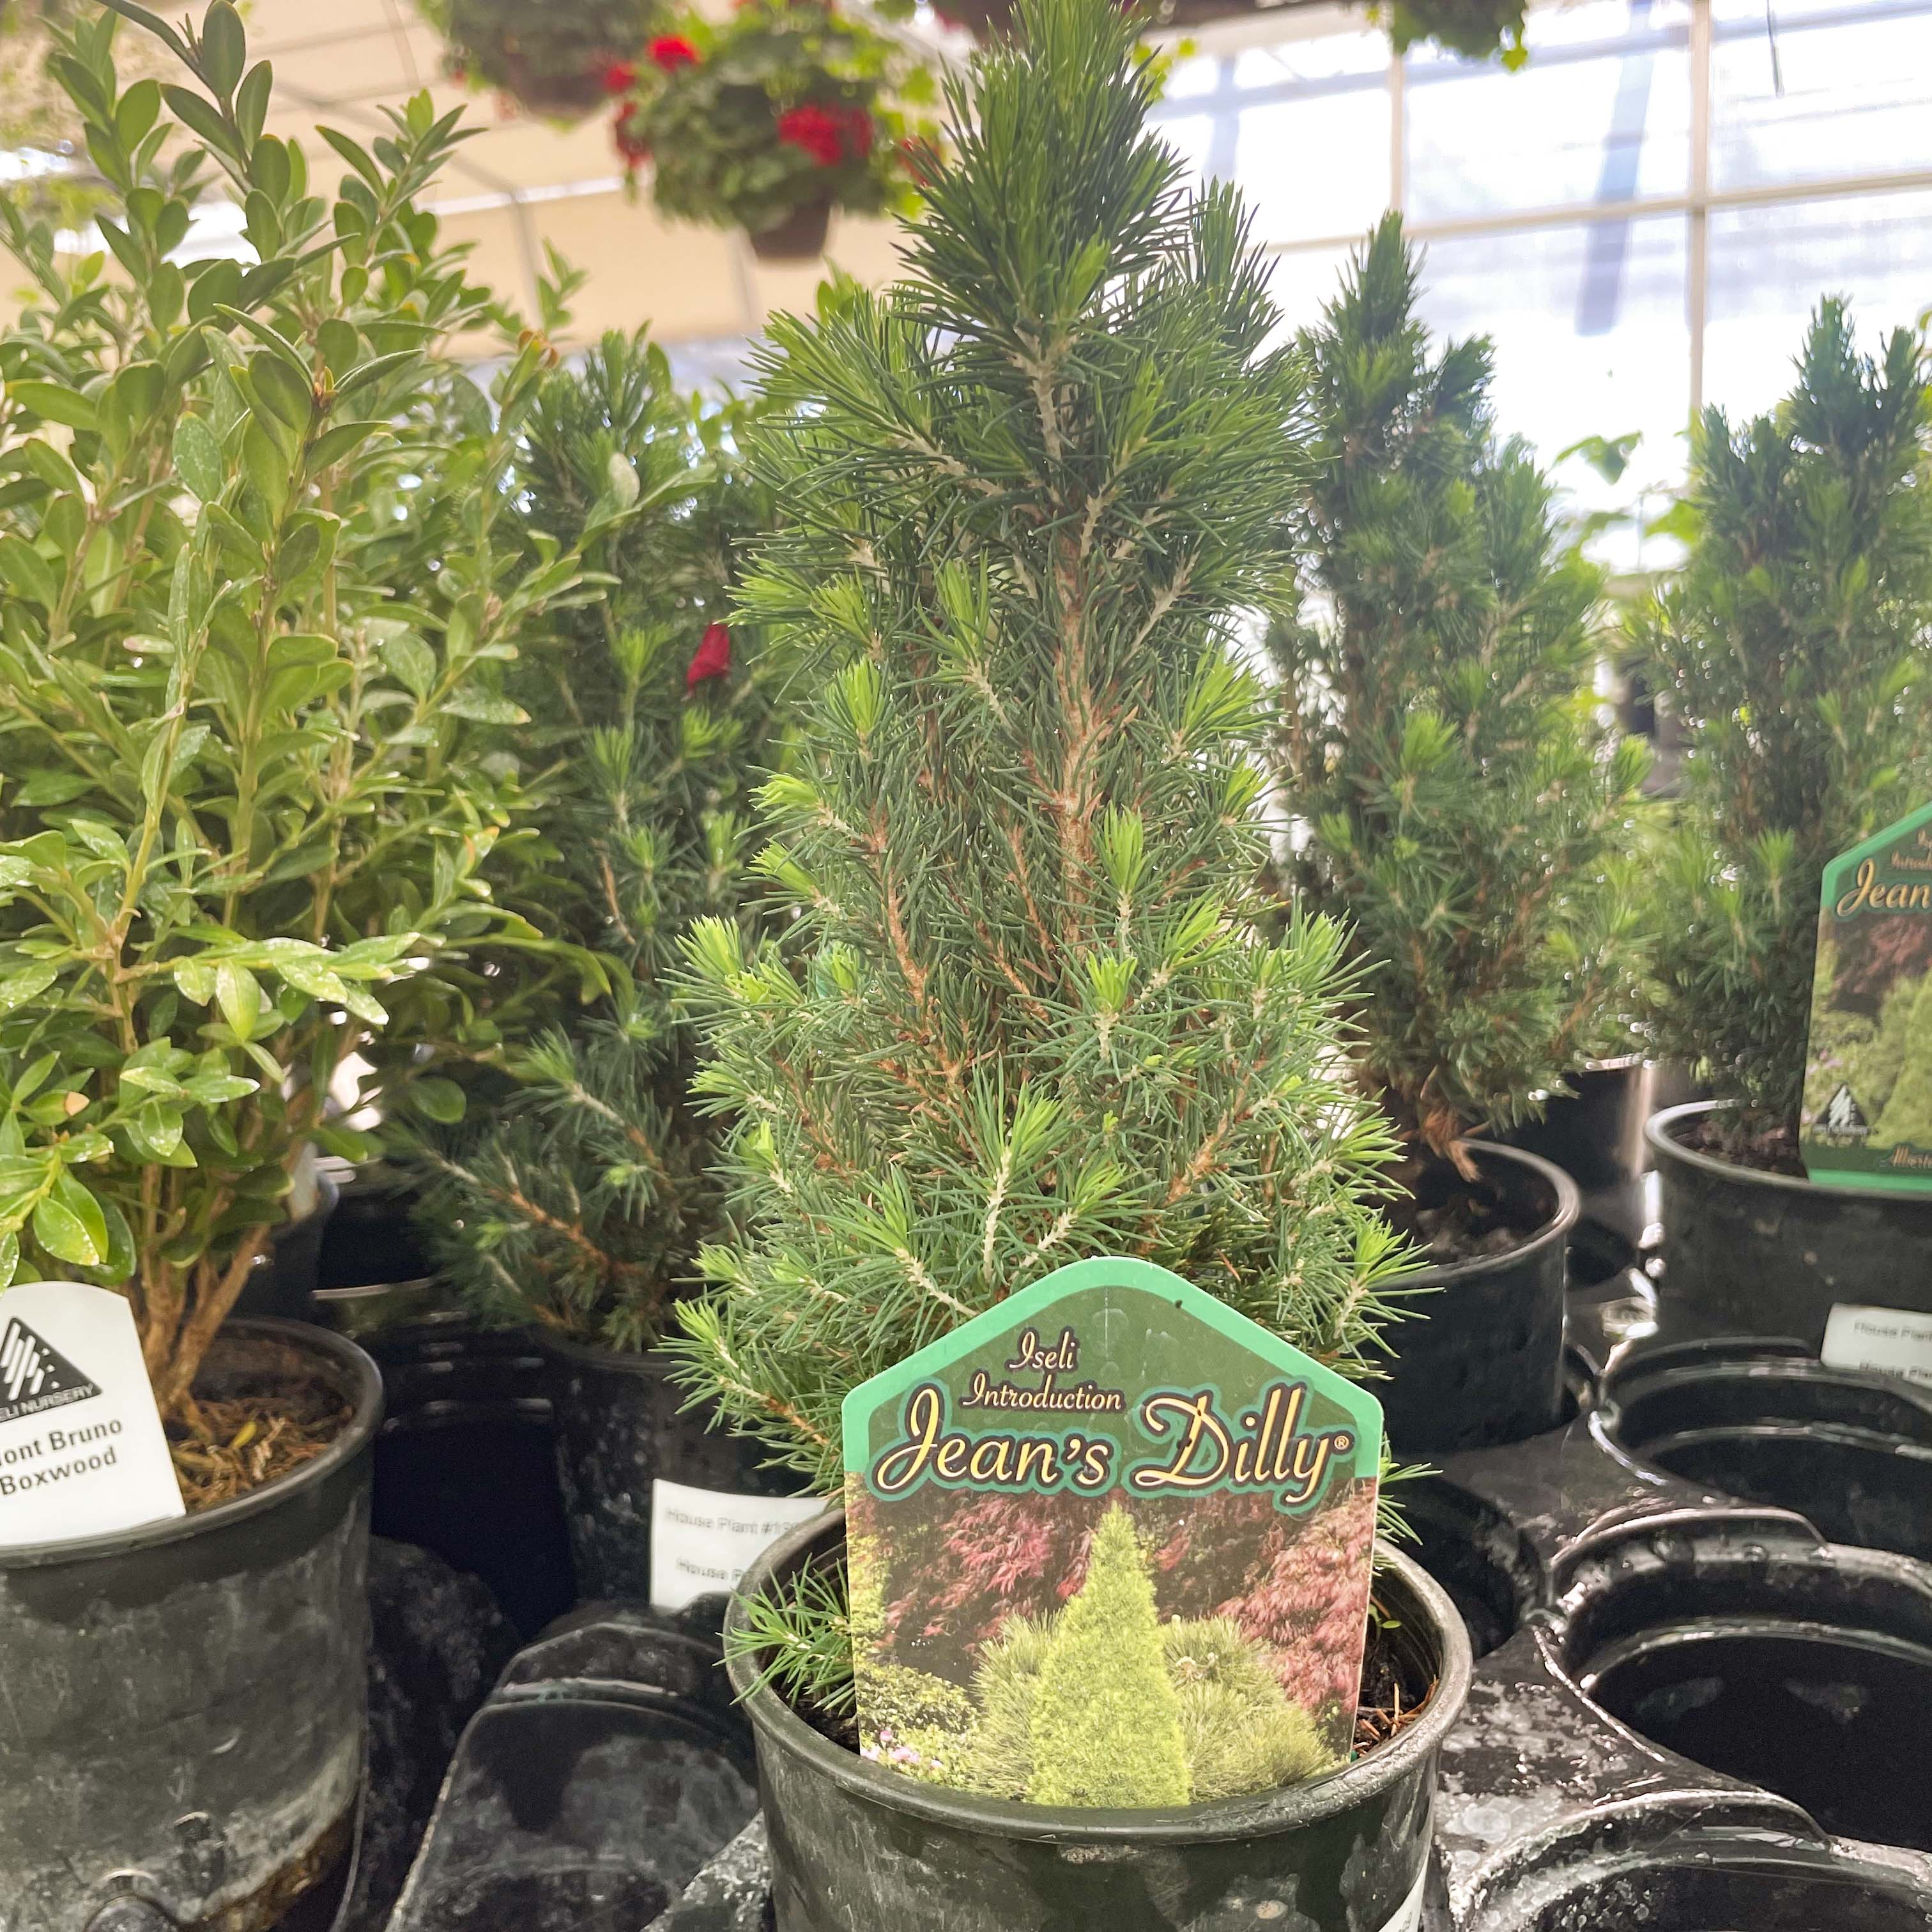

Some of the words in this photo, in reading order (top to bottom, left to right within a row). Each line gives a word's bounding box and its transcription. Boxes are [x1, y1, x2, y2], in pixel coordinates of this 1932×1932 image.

[1009, 1330, 1077, 1370] Iseli
[20, 1382, 95, 1414] NURSERY
[962, 1373, 1123, 1411] Introduction
[0, 1440, 42, 1468] ont
[49, 1419, 122, 1451] Bruno
[877, 1387, 1113, 1491] Jean's
[0, 1446, 117, 1496] Boxwood
[666, 1506, 714, 1529] House
